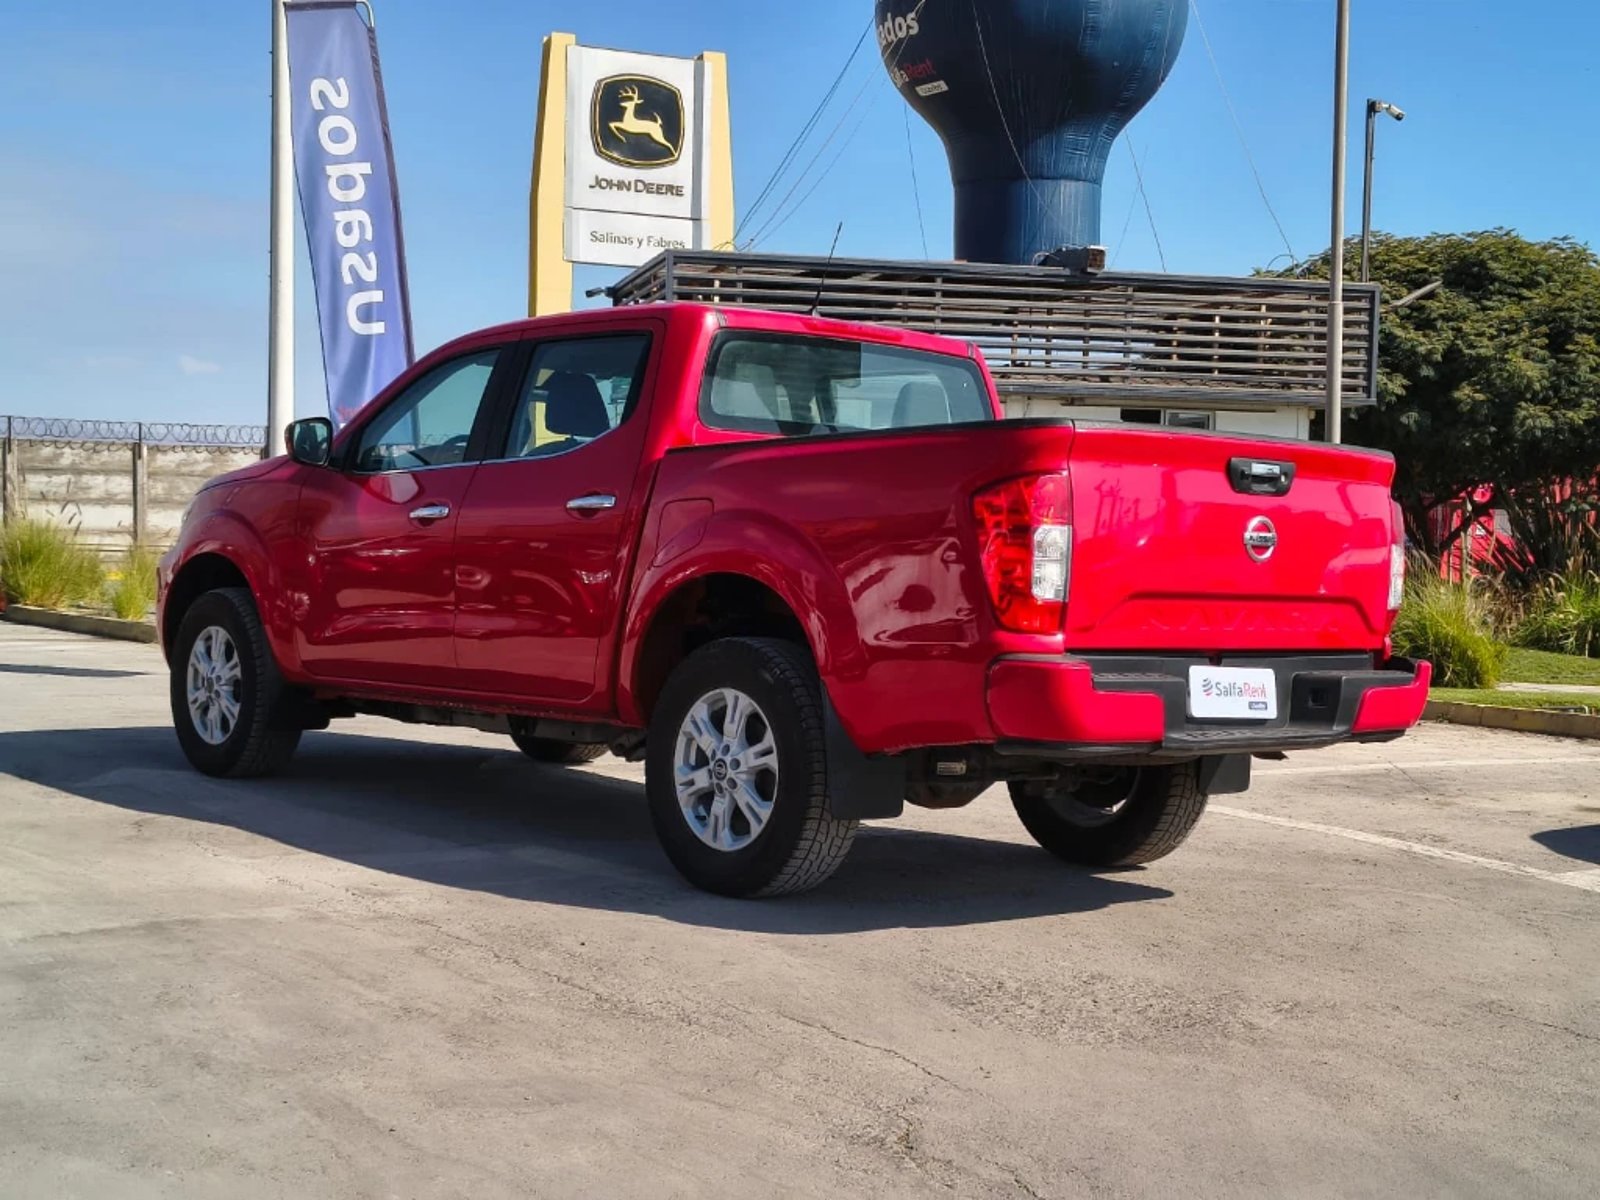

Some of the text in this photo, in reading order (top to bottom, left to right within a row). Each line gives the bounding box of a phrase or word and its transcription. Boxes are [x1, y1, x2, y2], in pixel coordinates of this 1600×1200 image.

[588, 175, 685, 197] JOHN DEERE
[590, 230, 686, 249] Salinas y Fabres
[1215, 681, 1267, 698] SalfaRent
